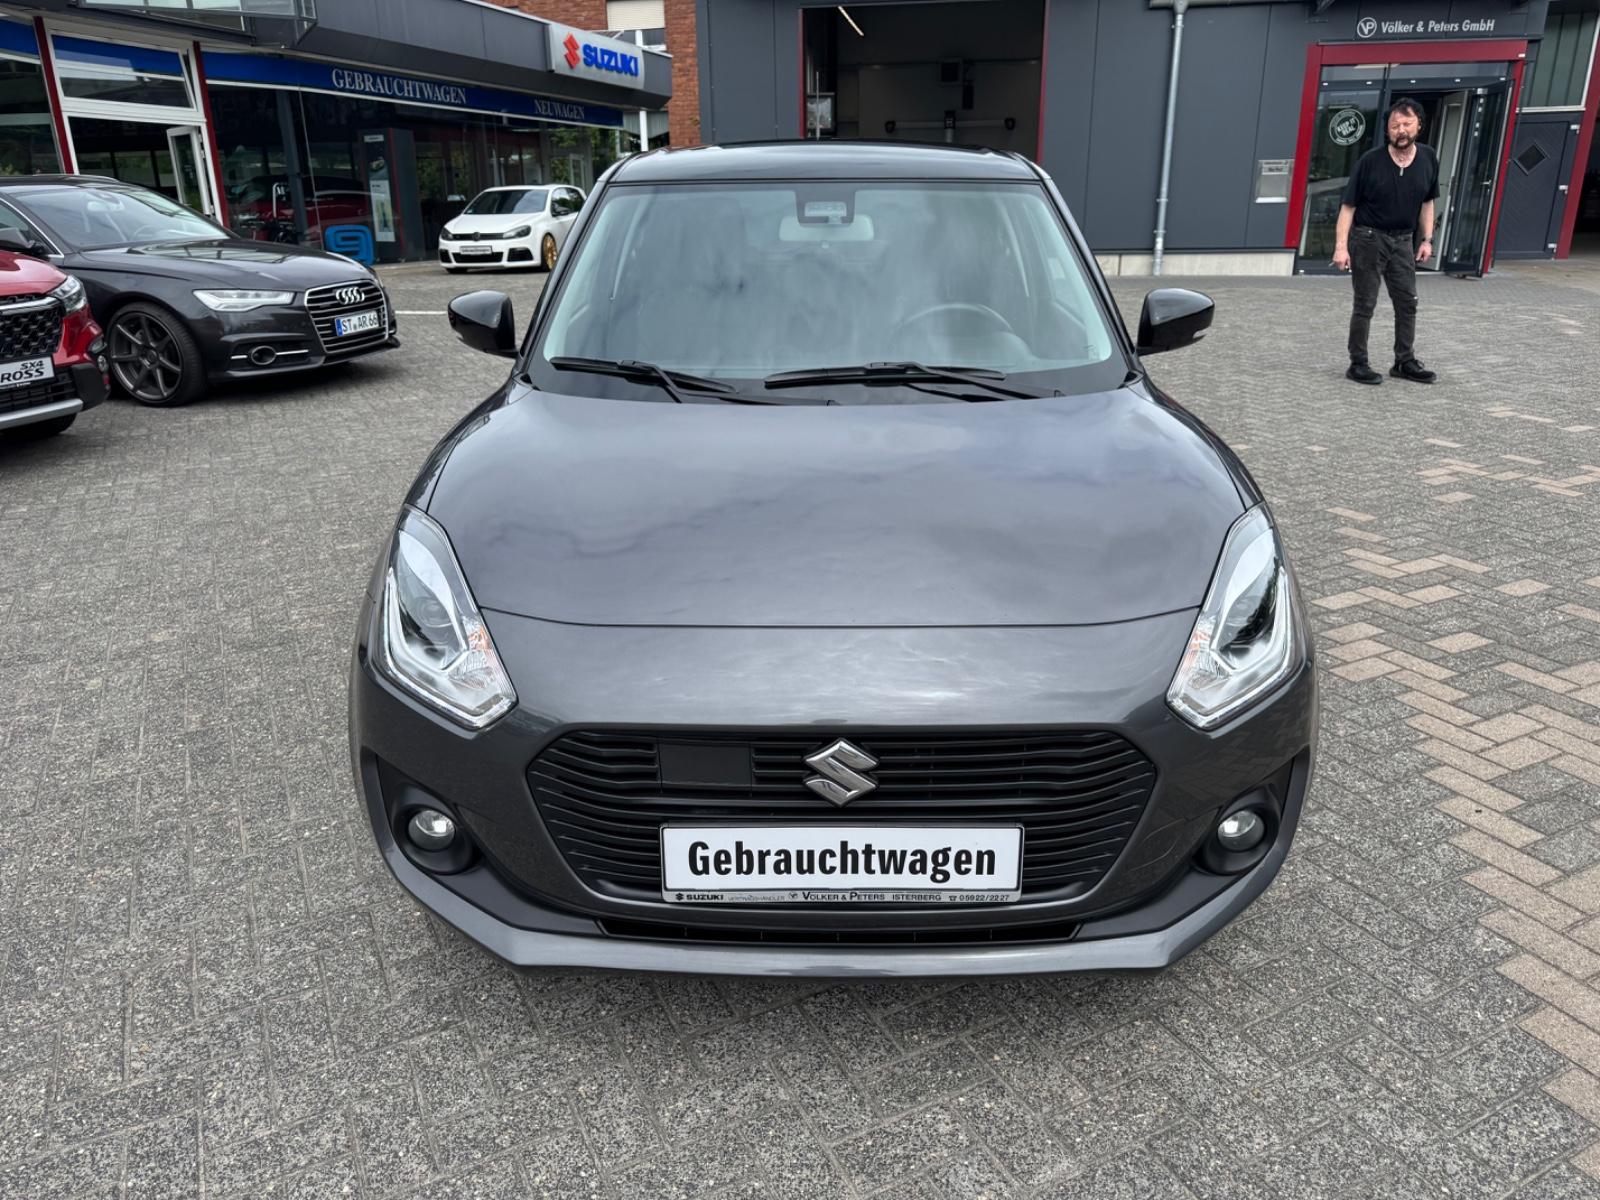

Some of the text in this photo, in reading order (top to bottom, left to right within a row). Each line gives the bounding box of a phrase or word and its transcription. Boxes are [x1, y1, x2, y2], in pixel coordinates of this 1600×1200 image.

[1381, 21, 1414, 33] Völker
[1416, 21, 1424, 32] &
[1428, 20, 1459, 32] Peters
[1462, 19, 1495, 31] GmbH
[583, 43, 639, 77] SUZUKI
[331, 68, 467, 104] GEBRAUCHTWAGEN
[534, 99, 585, 119] NEUWAGEN
[341, 319, 352, 333] ST
[358, 315, 368, 328] AR
[688, 841, 995, 883] Gebrauchtwagen
[850, 892, 885, 900] PETERS
